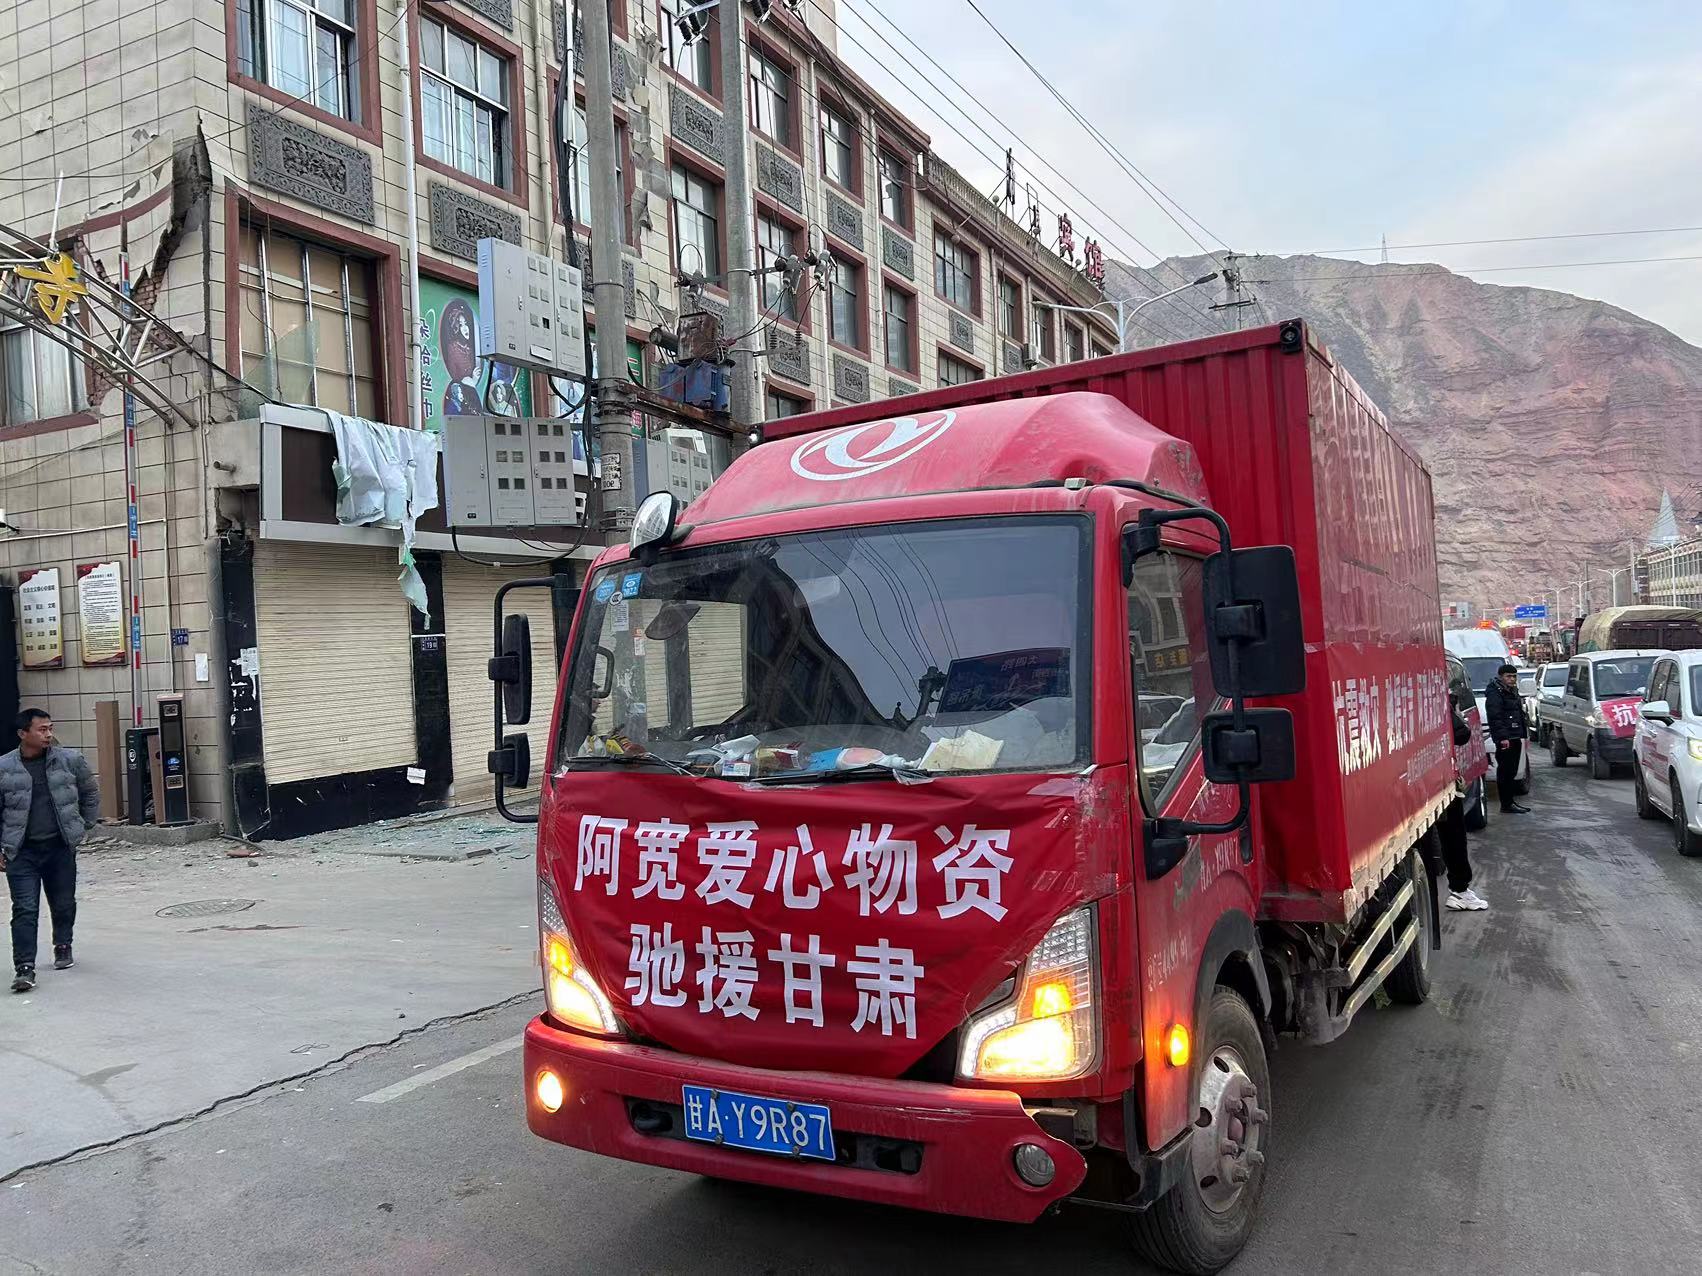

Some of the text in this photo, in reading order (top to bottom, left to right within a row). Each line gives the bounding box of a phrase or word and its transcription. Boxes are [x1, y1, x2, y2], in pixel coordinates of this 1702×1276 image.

[1612, 703, 1639, 728] 抗
[573, 814, 1015, 923] 阿宽爱心物资
[624, 921, 924, 1040] 驰援甘肃
[688, 1093, 826, 1151] 甘A·Y9R87
